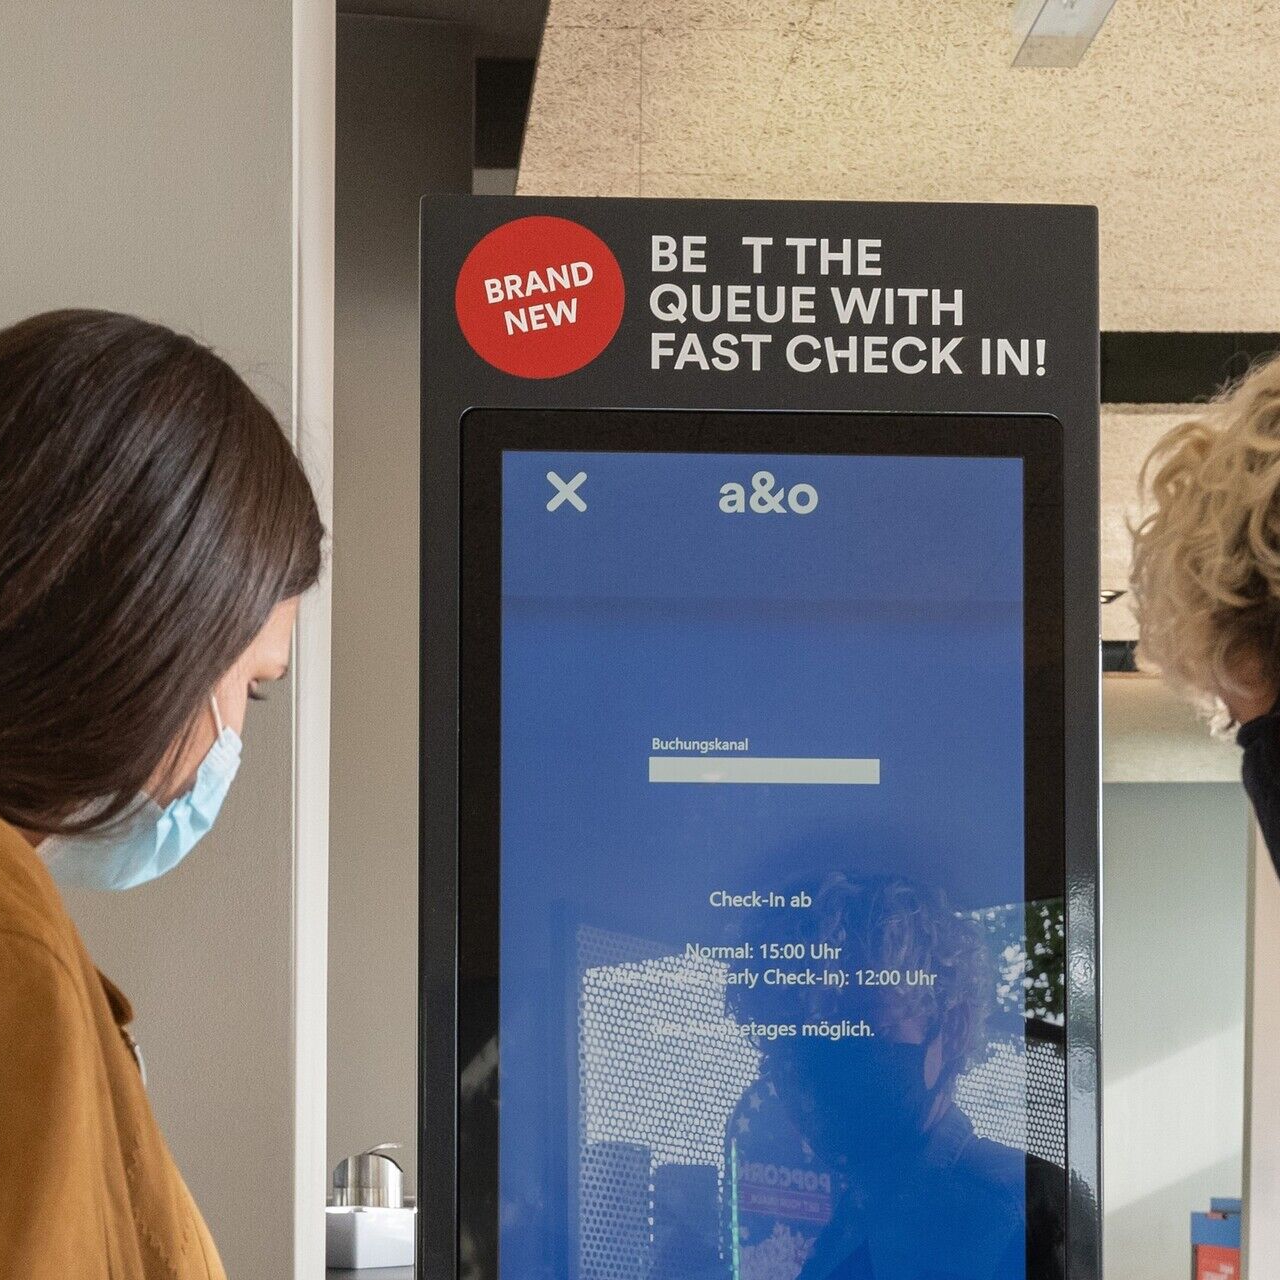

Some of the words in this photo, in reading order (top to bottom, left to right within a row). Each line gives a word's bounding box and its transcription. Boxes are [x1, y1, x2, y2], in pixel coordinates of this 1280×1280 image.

[651, 235, 773, 274] BET
[785, 237, 882, 276] THE
[484, 260, 594, 306] BRAND
[504, 297, 579, 336] NEW
[650, 283, 816, 324] QUEUE
[831, 287, 963, 326] WITH
[651, 333, 772, 371] FAST
[786, 335, 963, 375] CHECK
[981, 339, 1046, 377] IN!
[719, 471, 819, 515] a&o
[652, 737, 749, 754] Buchungskanal
[709, 891, 785, 908] Check-In
[791, 891, 812, 908] ab
[686, 943, 754, 960] Normal:
[760, 944, 805, 960] 15:00
[810, 943, 842, 960] Uhr
[763, 968, 850, 988] Check-In):
[855, 969, 901, 986] 12:00
[905, 969, 938, 986] Uhr
[802, 1020, 875, 1041] möglich.
